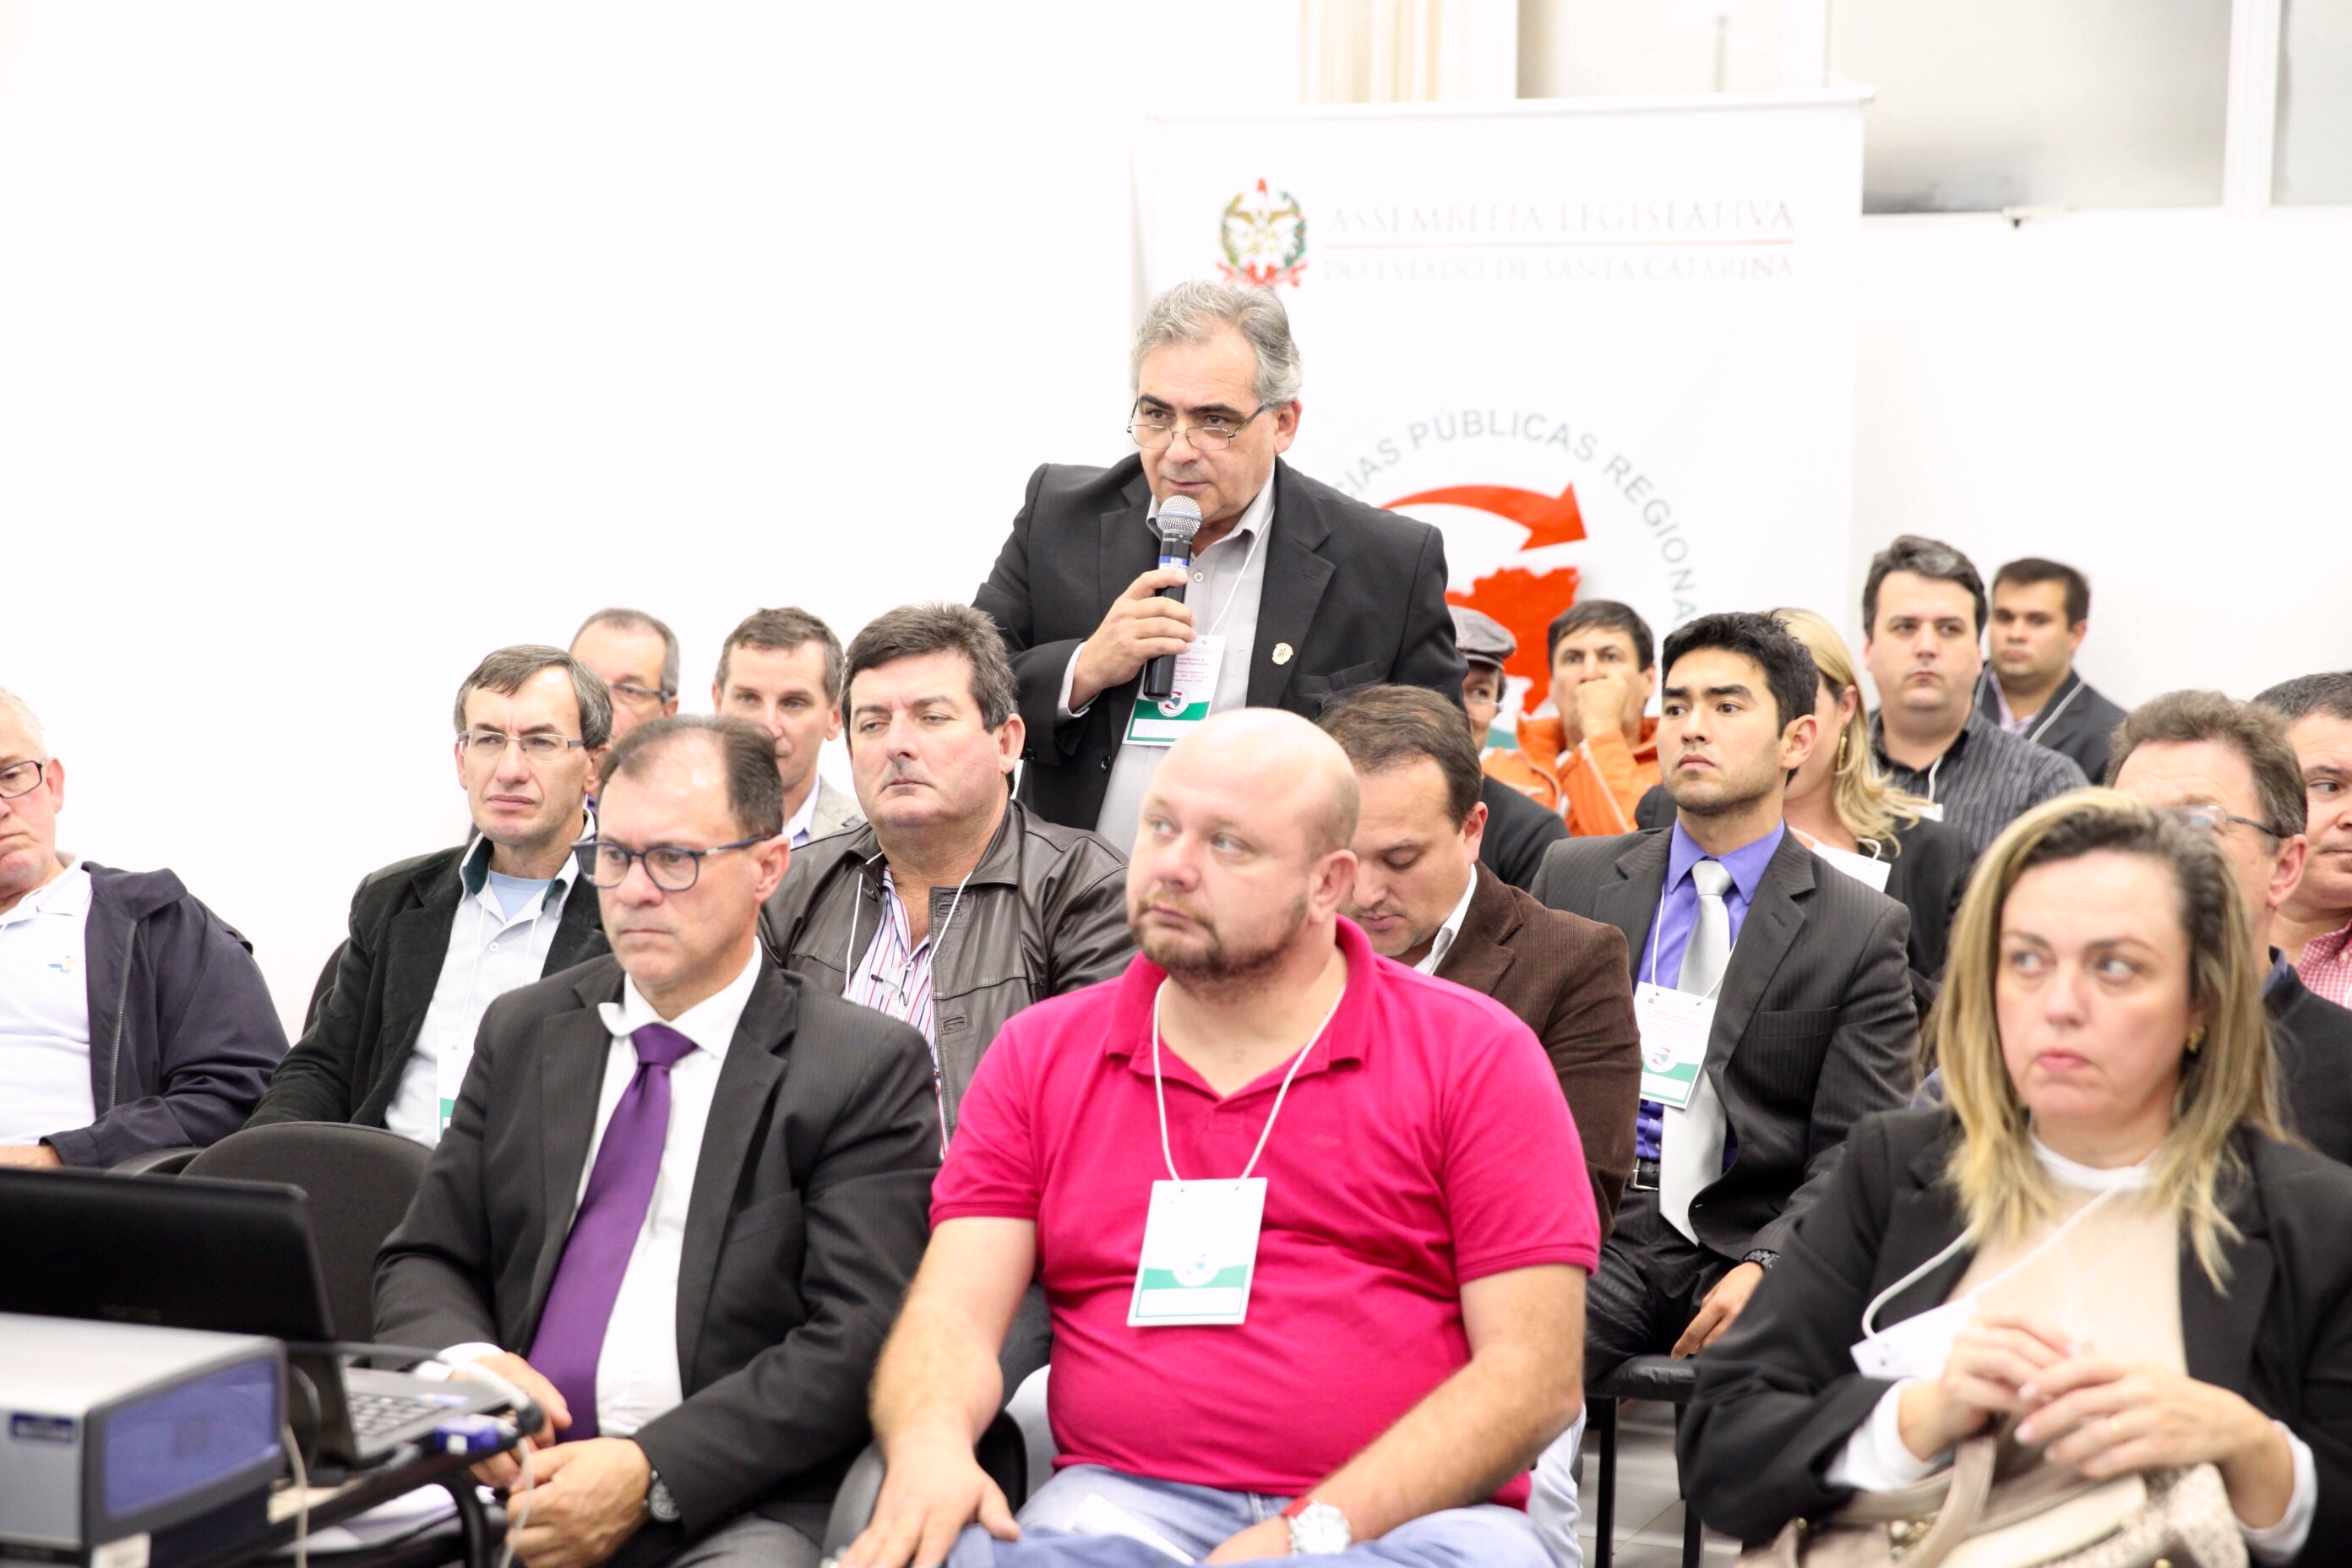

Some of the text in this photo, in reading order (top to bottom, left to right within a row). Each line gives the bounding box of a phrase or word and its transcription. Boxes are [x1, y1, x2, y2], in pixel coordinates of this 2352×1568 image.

[1327, 199, 1794, 232] ASSEMBLEIA LEGISLATIVA
[1320, 257, 1368, 281] DO
[1378, 256, 1486, 281] ESTADO
[1544, 257, 1636, 280] SANTA
[1642, 254, 1794, 280] CATARINA
[1335, 406, 1699, 626] IAS PÚBLICAS REGIONA
